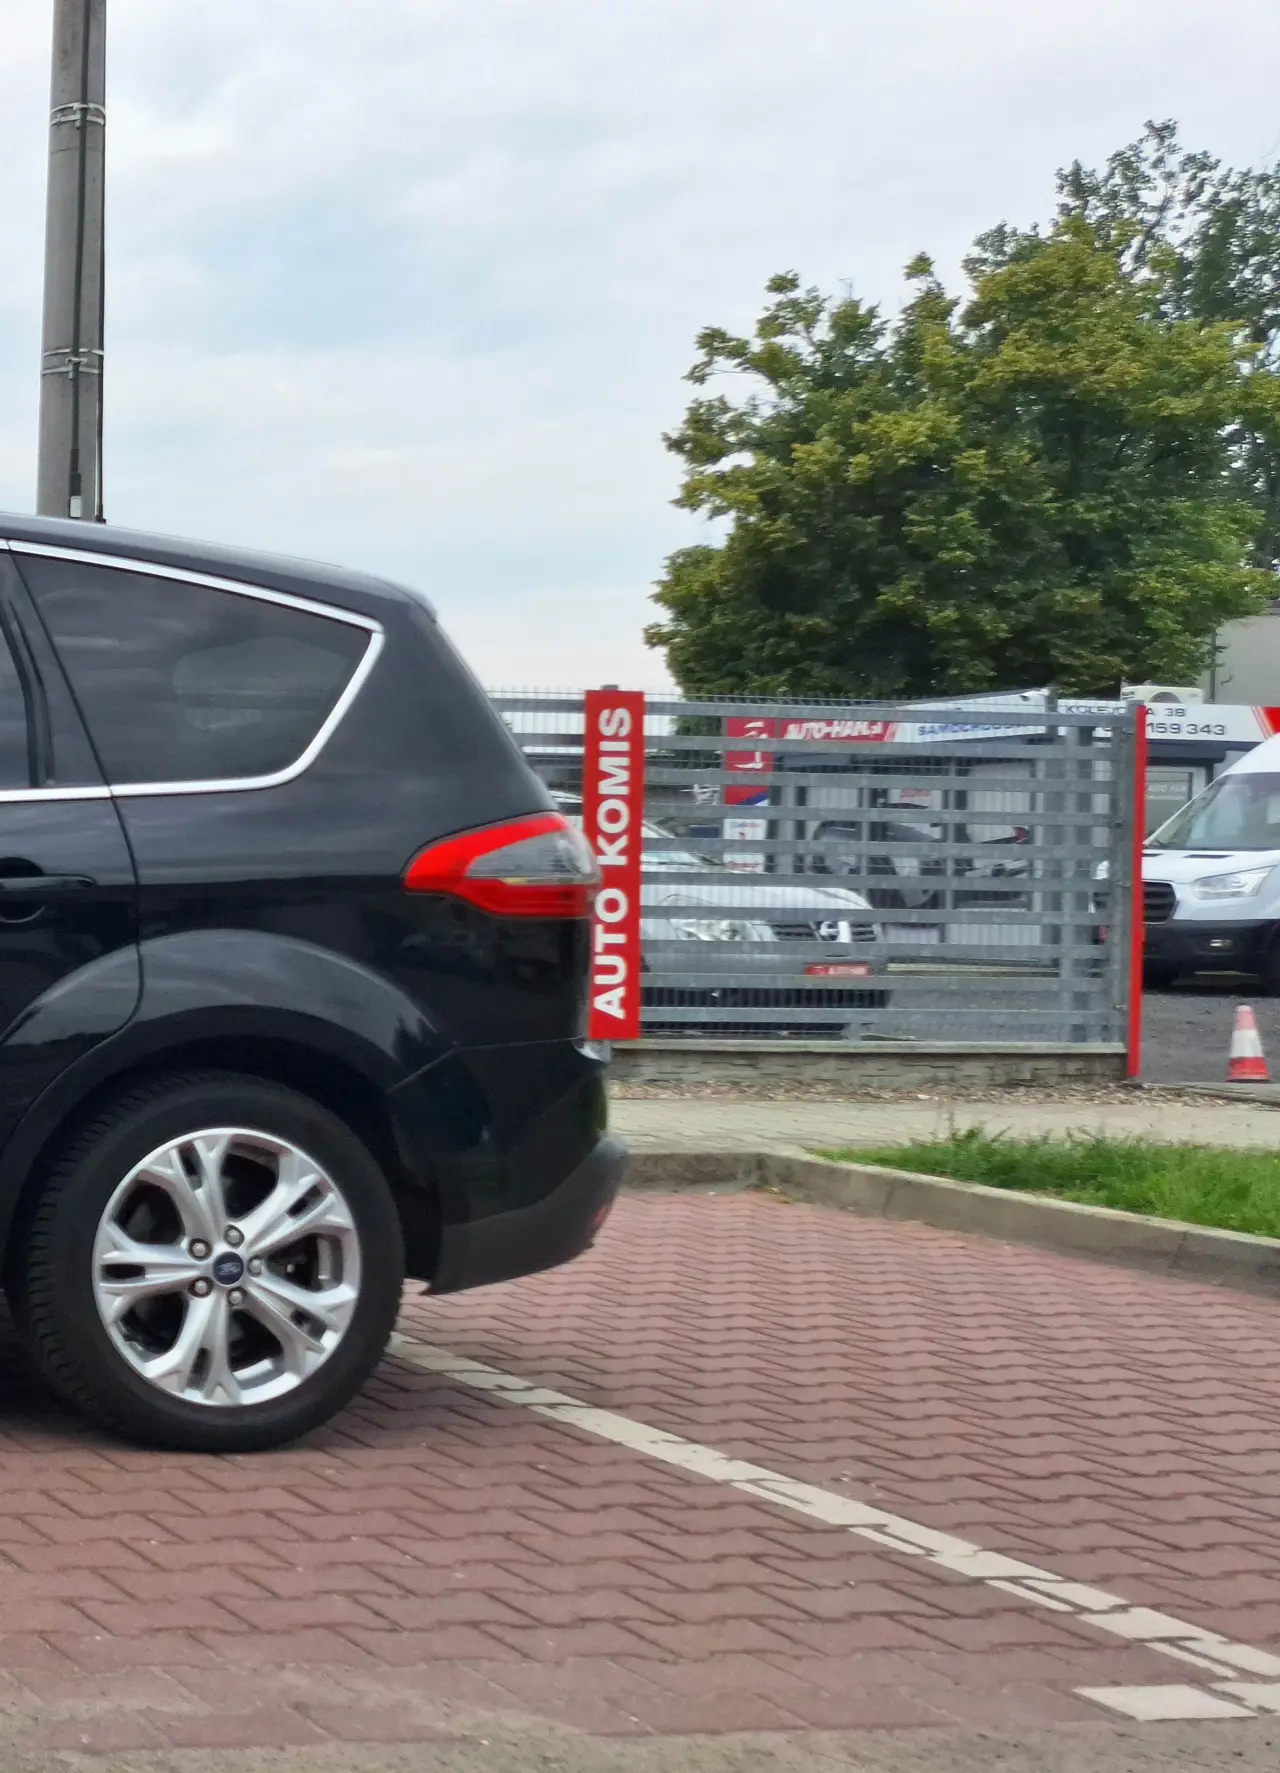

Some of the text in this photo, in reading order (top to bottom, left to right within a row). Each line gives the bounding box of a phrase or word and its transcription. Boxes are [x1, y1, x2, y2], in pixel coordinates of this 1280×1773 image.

[1186, 723, 1225, 736] 343
[593, 706, 631, 1020] AUTO KOMIS
